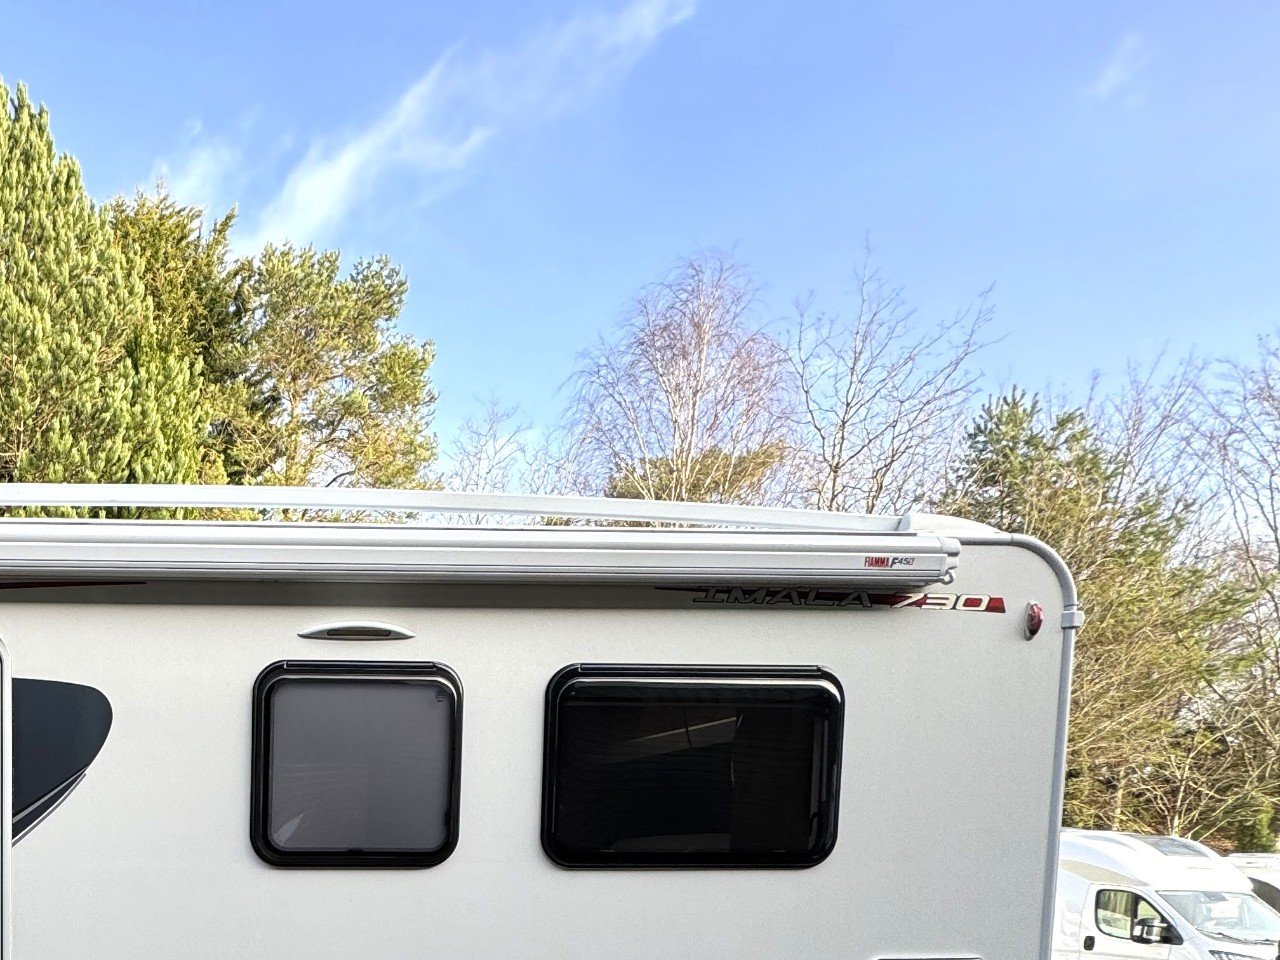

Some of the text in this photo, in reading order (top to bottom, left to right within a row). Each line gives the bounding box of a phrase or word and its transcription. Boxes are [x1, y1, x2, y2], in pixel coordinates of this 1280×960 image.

[864, 556, 890, 568] FIAMMA
[692, 586, 992, 612] IMALA 730
